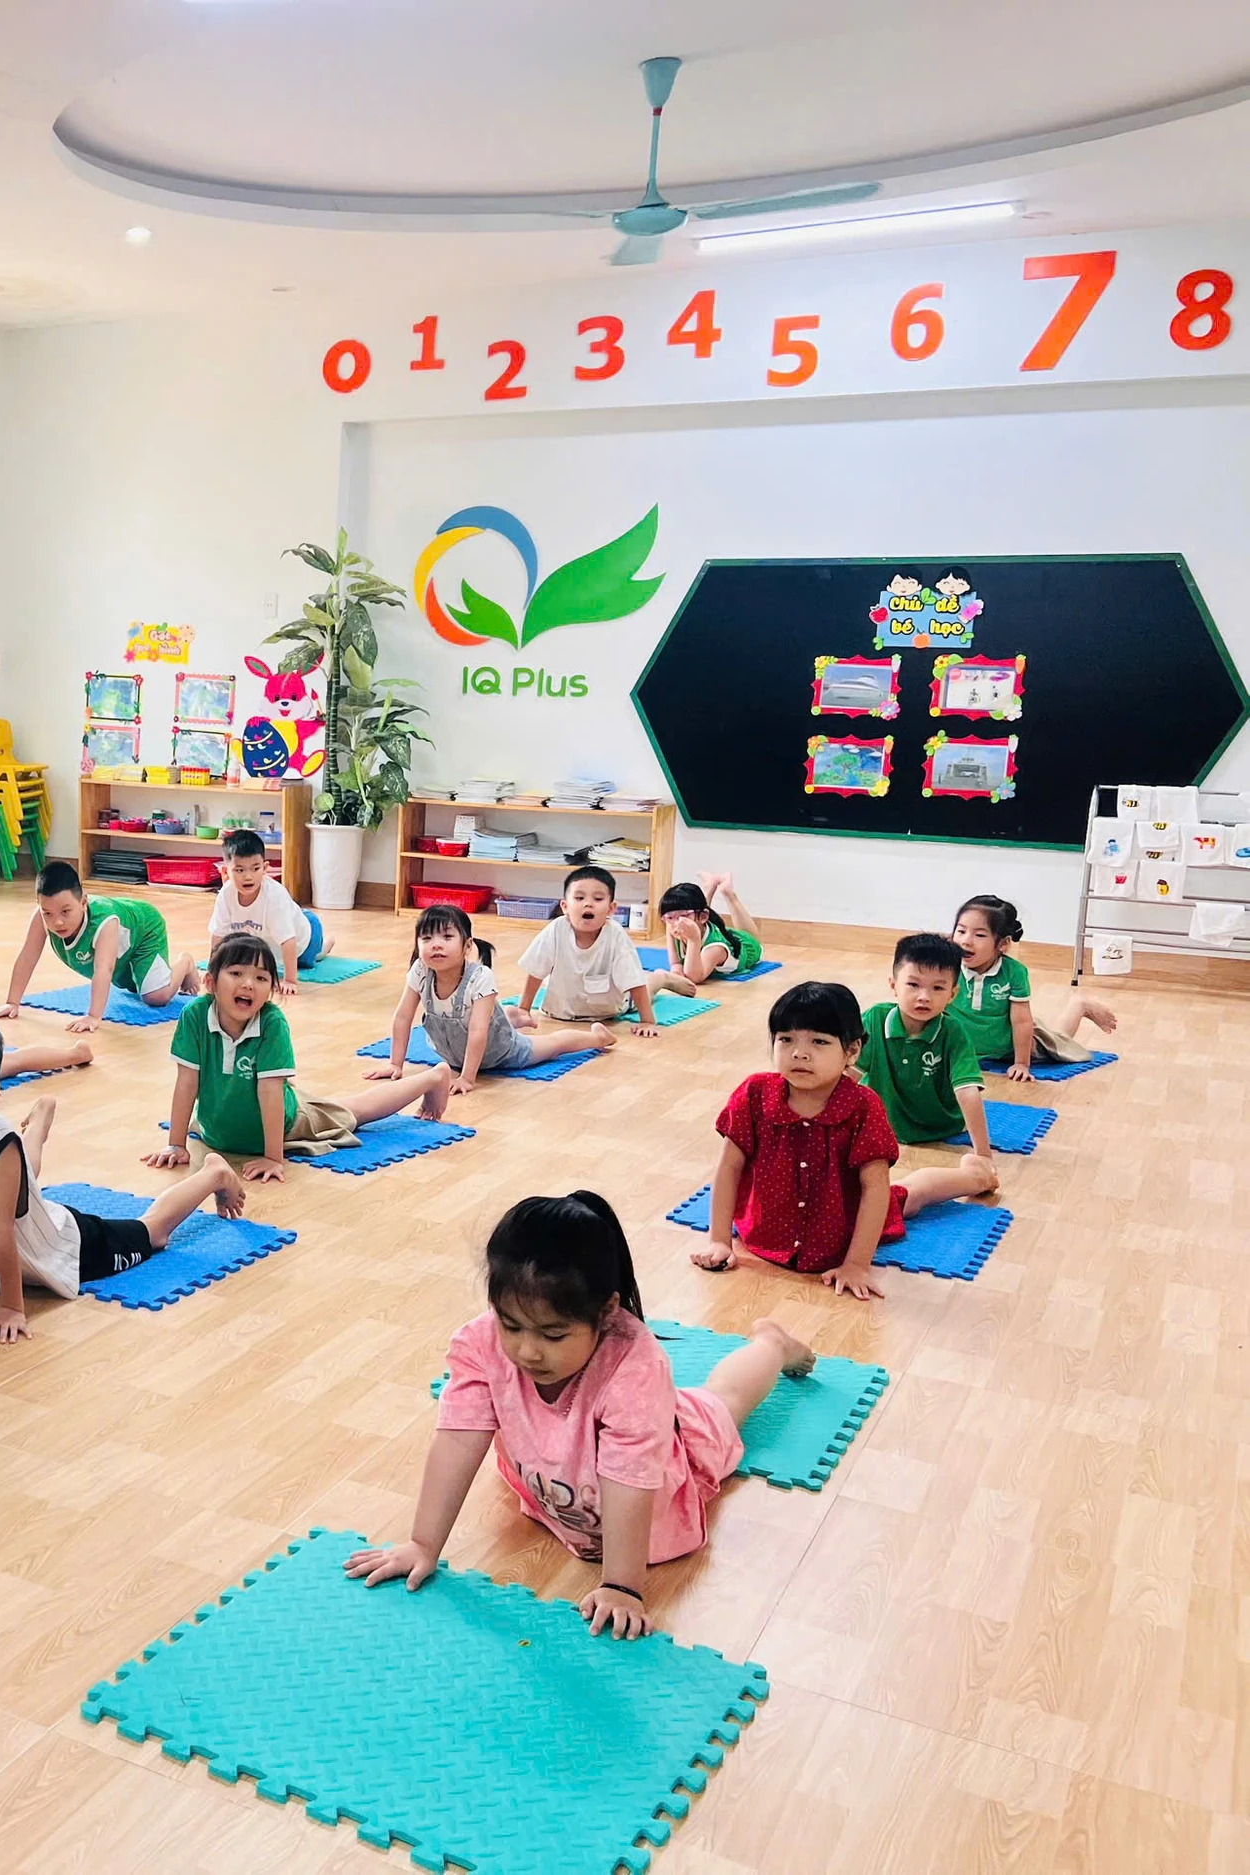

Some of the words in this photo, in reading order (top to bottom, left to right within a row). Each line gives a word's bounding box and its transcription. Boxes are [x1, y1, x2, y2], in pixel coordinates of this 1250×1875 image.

[322, 338, 372, 394] 0
[410, 315, 446, 371] 1
[484, 340, 527, 401] 2
[574, 315, 625, 381] 3
[667, 289, 722, 359] 4
[766, 315, 821, 388] 5
[890, 282, 945, 362] 6
[1019, 250, 1118, 372] 7
[1169, 269, 1234, 351] 8
[889, 594, 924, 611] Chủ
[935, 594, 961, 613] đề
[890, 618, 915, 635] bé
[929, 619, 965, 638] học
[462, 666, 502, 695] IQ
[512, 667, 589, 697] Plus
